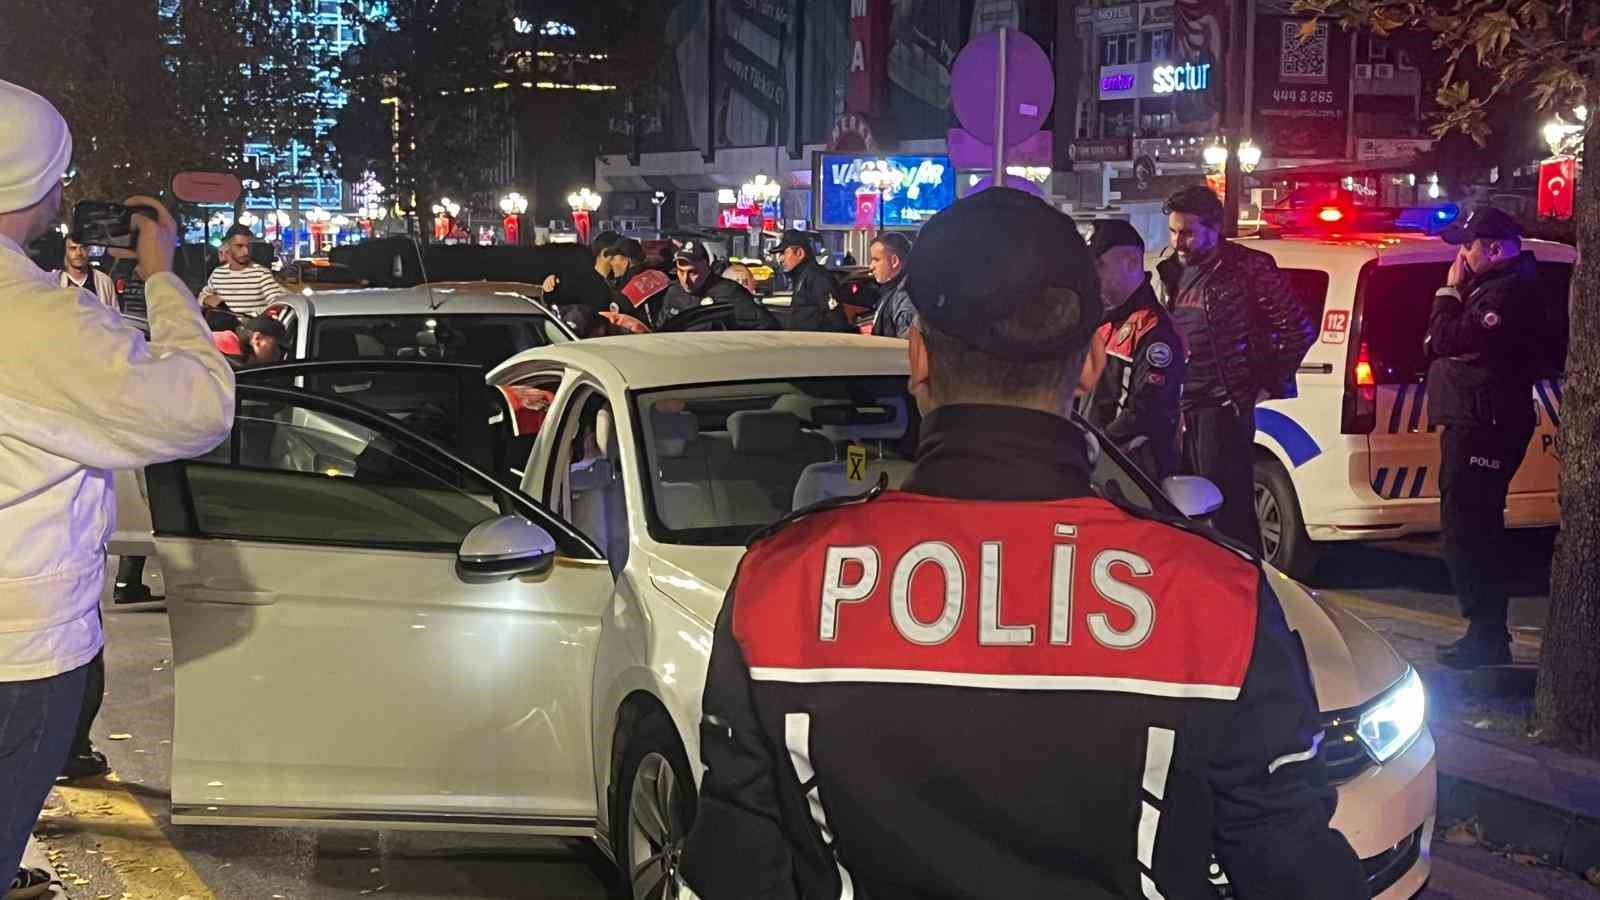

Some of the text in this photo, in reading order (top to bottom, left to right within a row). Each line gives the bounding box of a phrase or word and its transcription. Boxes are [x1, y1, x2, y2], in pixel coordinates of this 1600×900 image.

[1152, 62, 1210, 93] ssctur
[1273, 89, 1296, 102] 444
[1299, 90, 1308, 103] 3
[1327, 313, 1345, 330] 112
[818, 523, 1156, 649] POLİS
